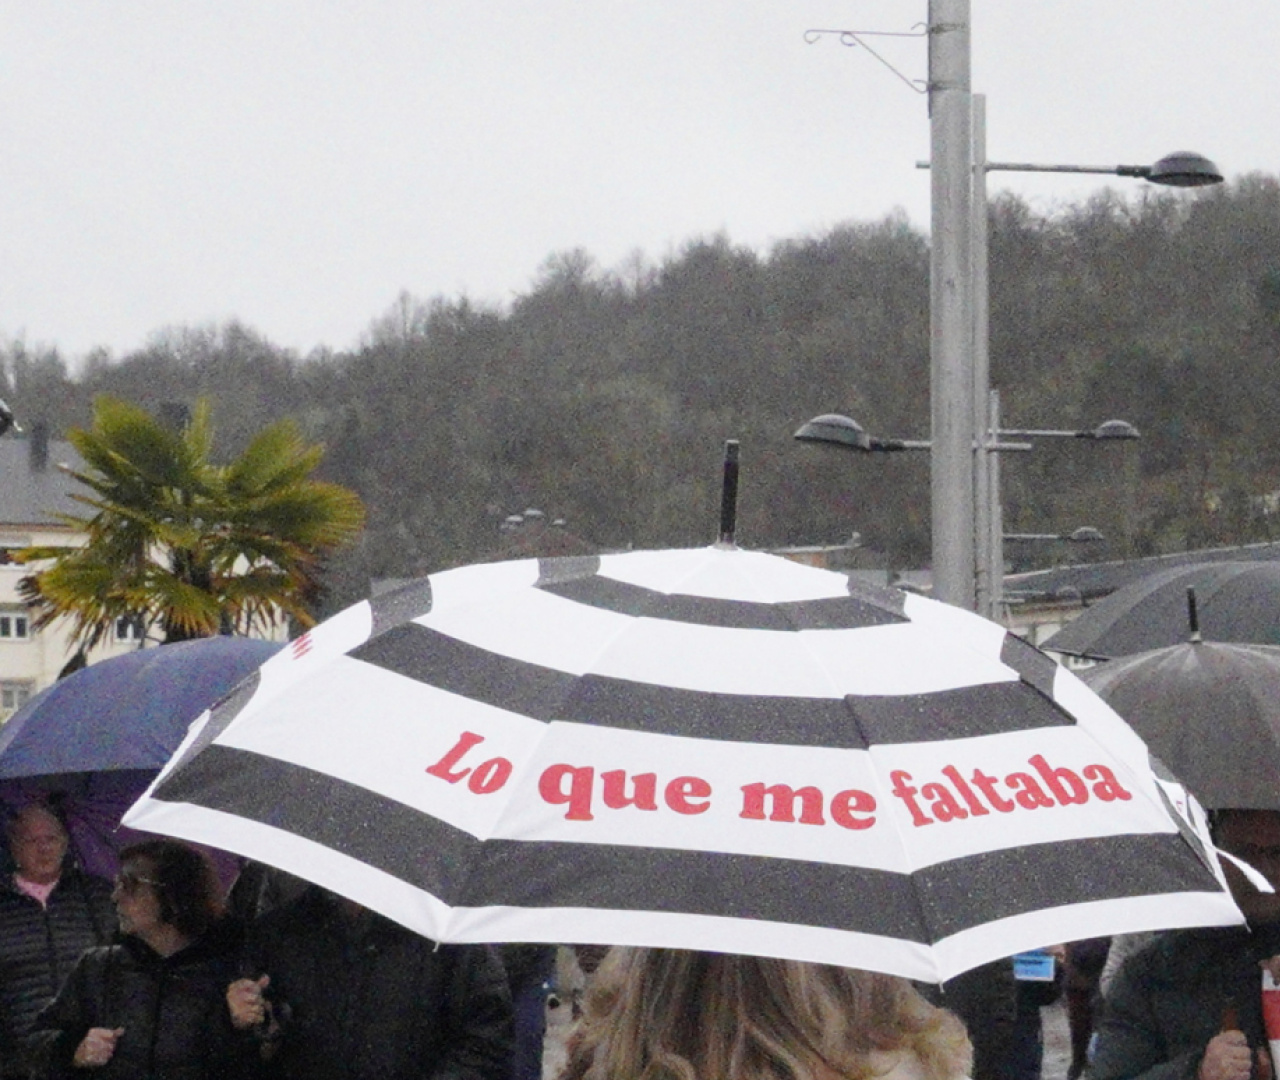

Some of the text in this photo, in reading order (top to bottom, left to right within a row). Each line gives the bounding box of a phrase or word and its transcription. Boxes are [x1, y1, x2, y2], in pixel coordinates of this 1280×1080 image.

[426, 731, 1132, 831] Lo que me faltaba
